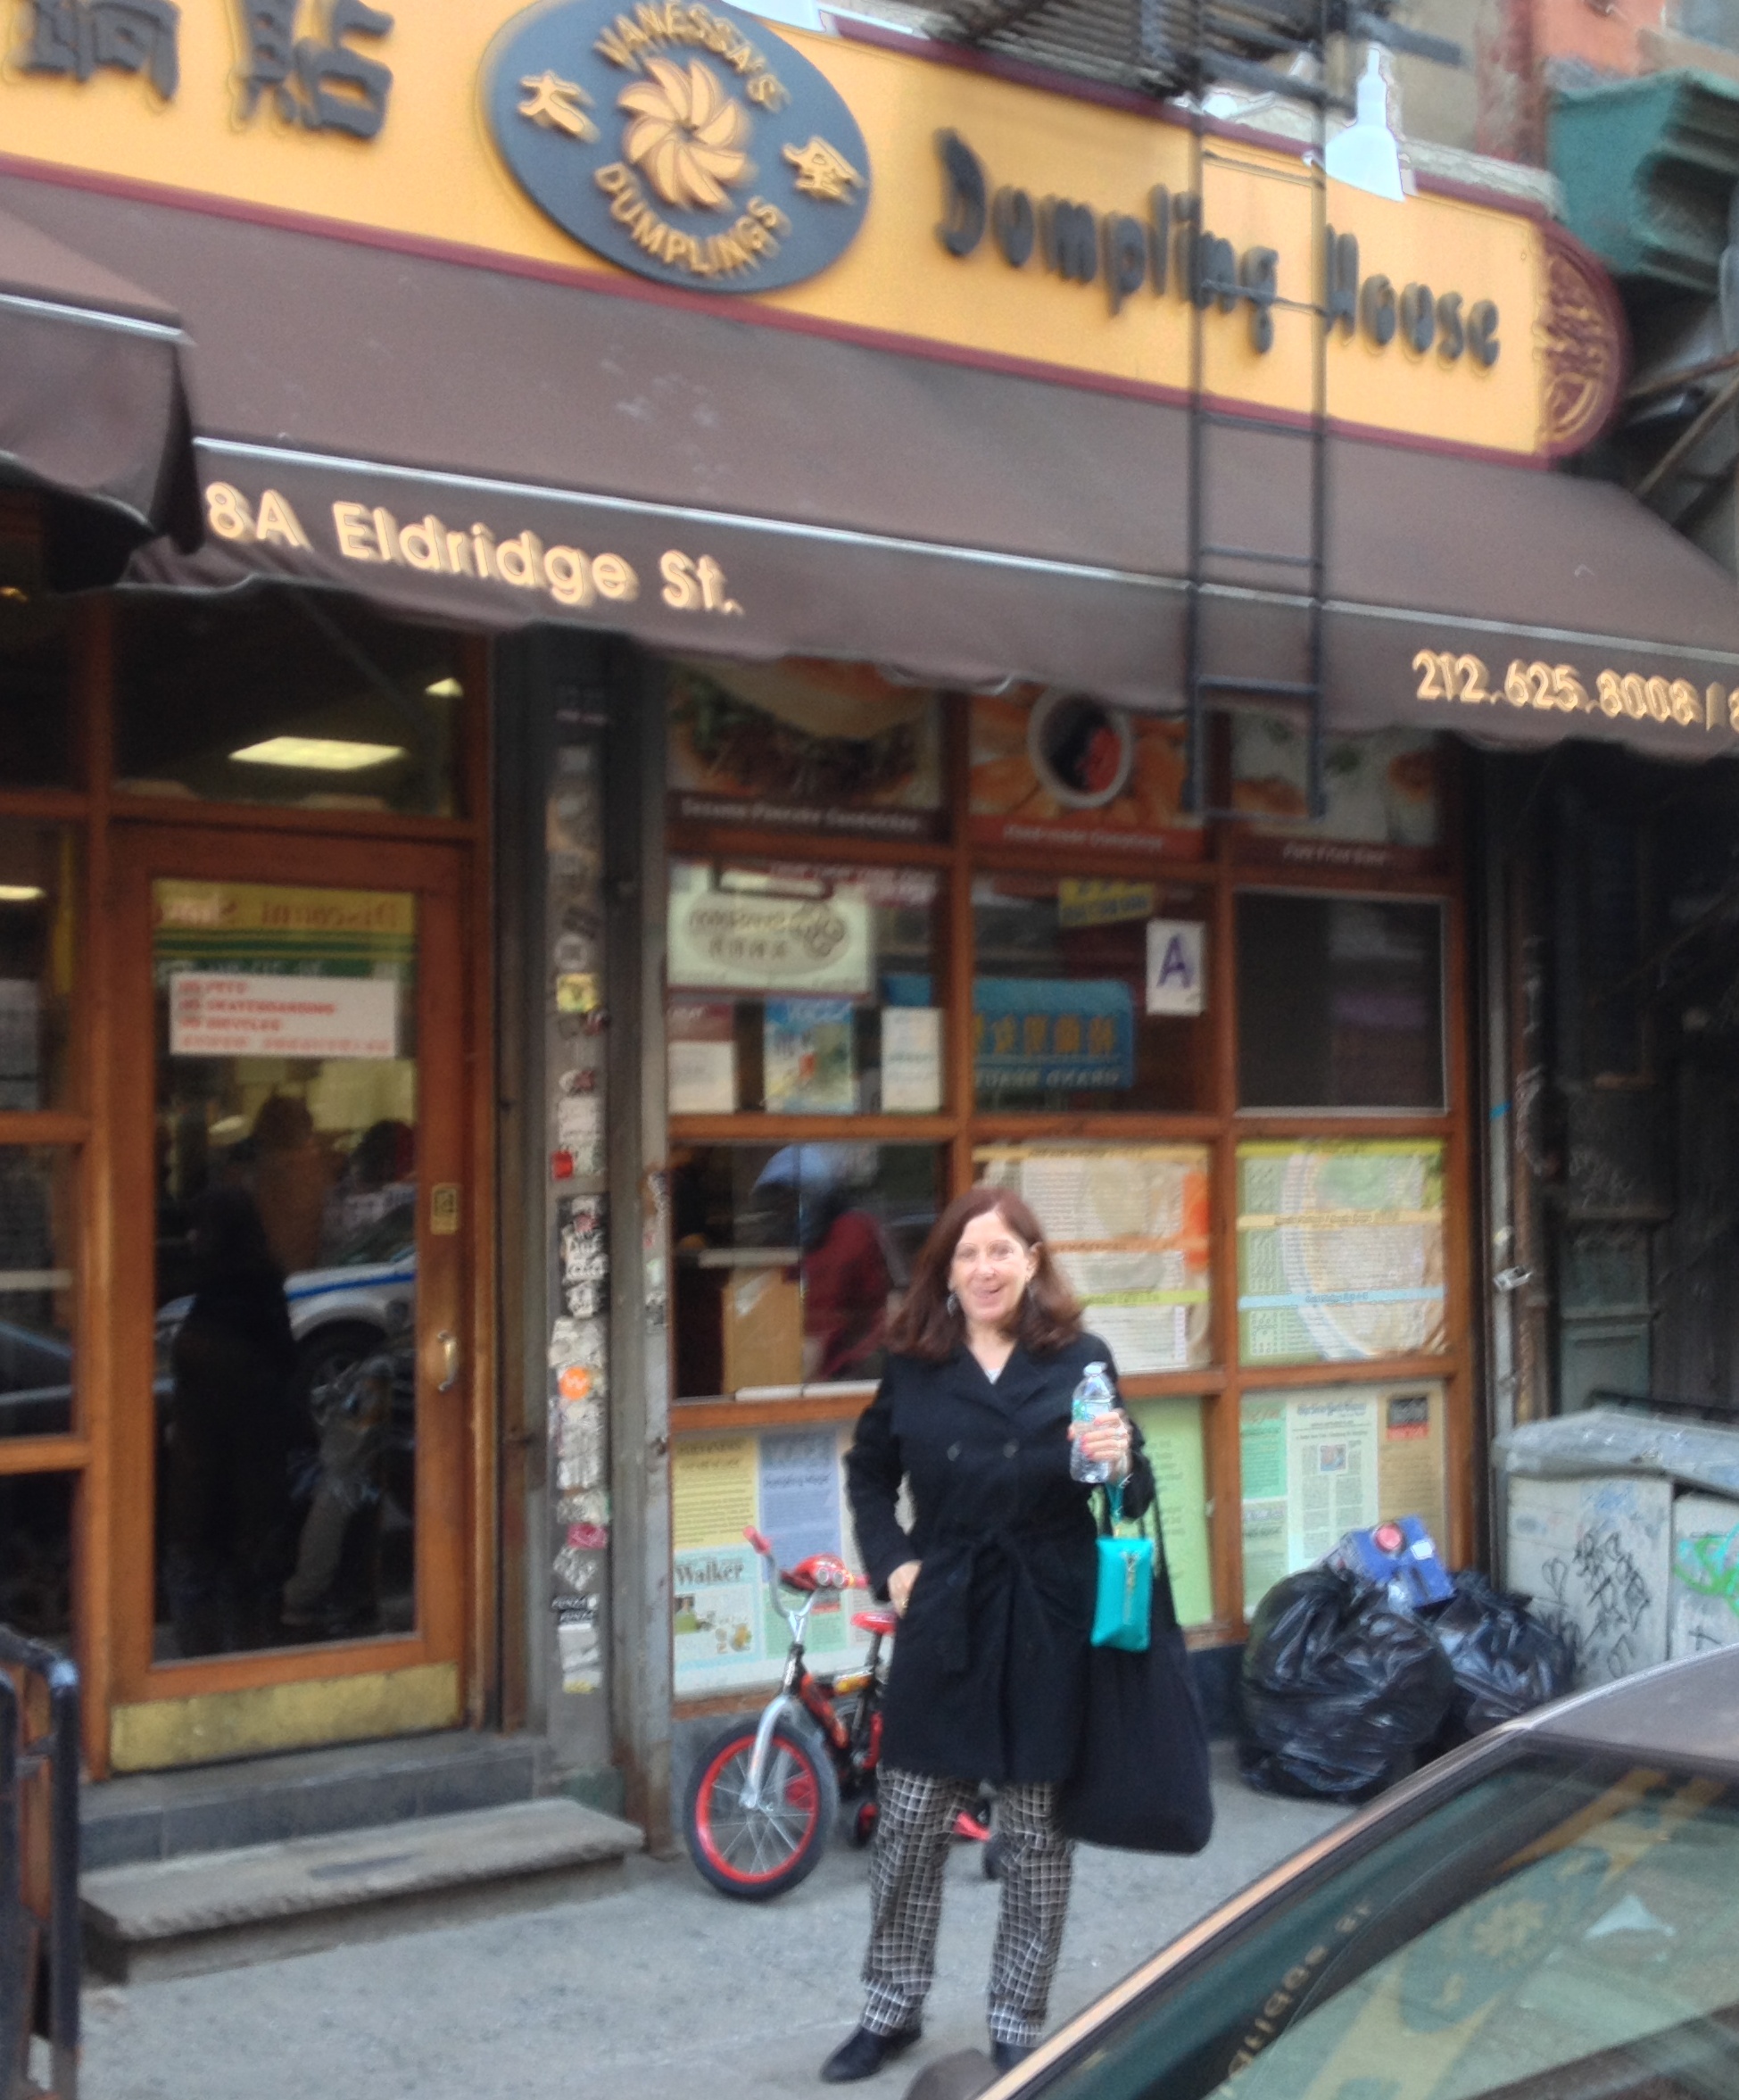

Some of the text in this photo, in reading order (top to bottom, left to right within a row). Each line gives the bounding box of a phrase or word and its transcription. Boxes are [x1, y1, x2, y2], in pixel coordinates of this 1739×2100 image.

[594, 162, 791, 278] DUMPLINGS
[934, 128, 1500, 368] Dumpling House
[332, 501, 638, 609] Eldridge
[660, 550, 743, 615] St.
[1412, 649, 1702, 726] 212.625.8008
[1157, 933, 1195, 989] A
